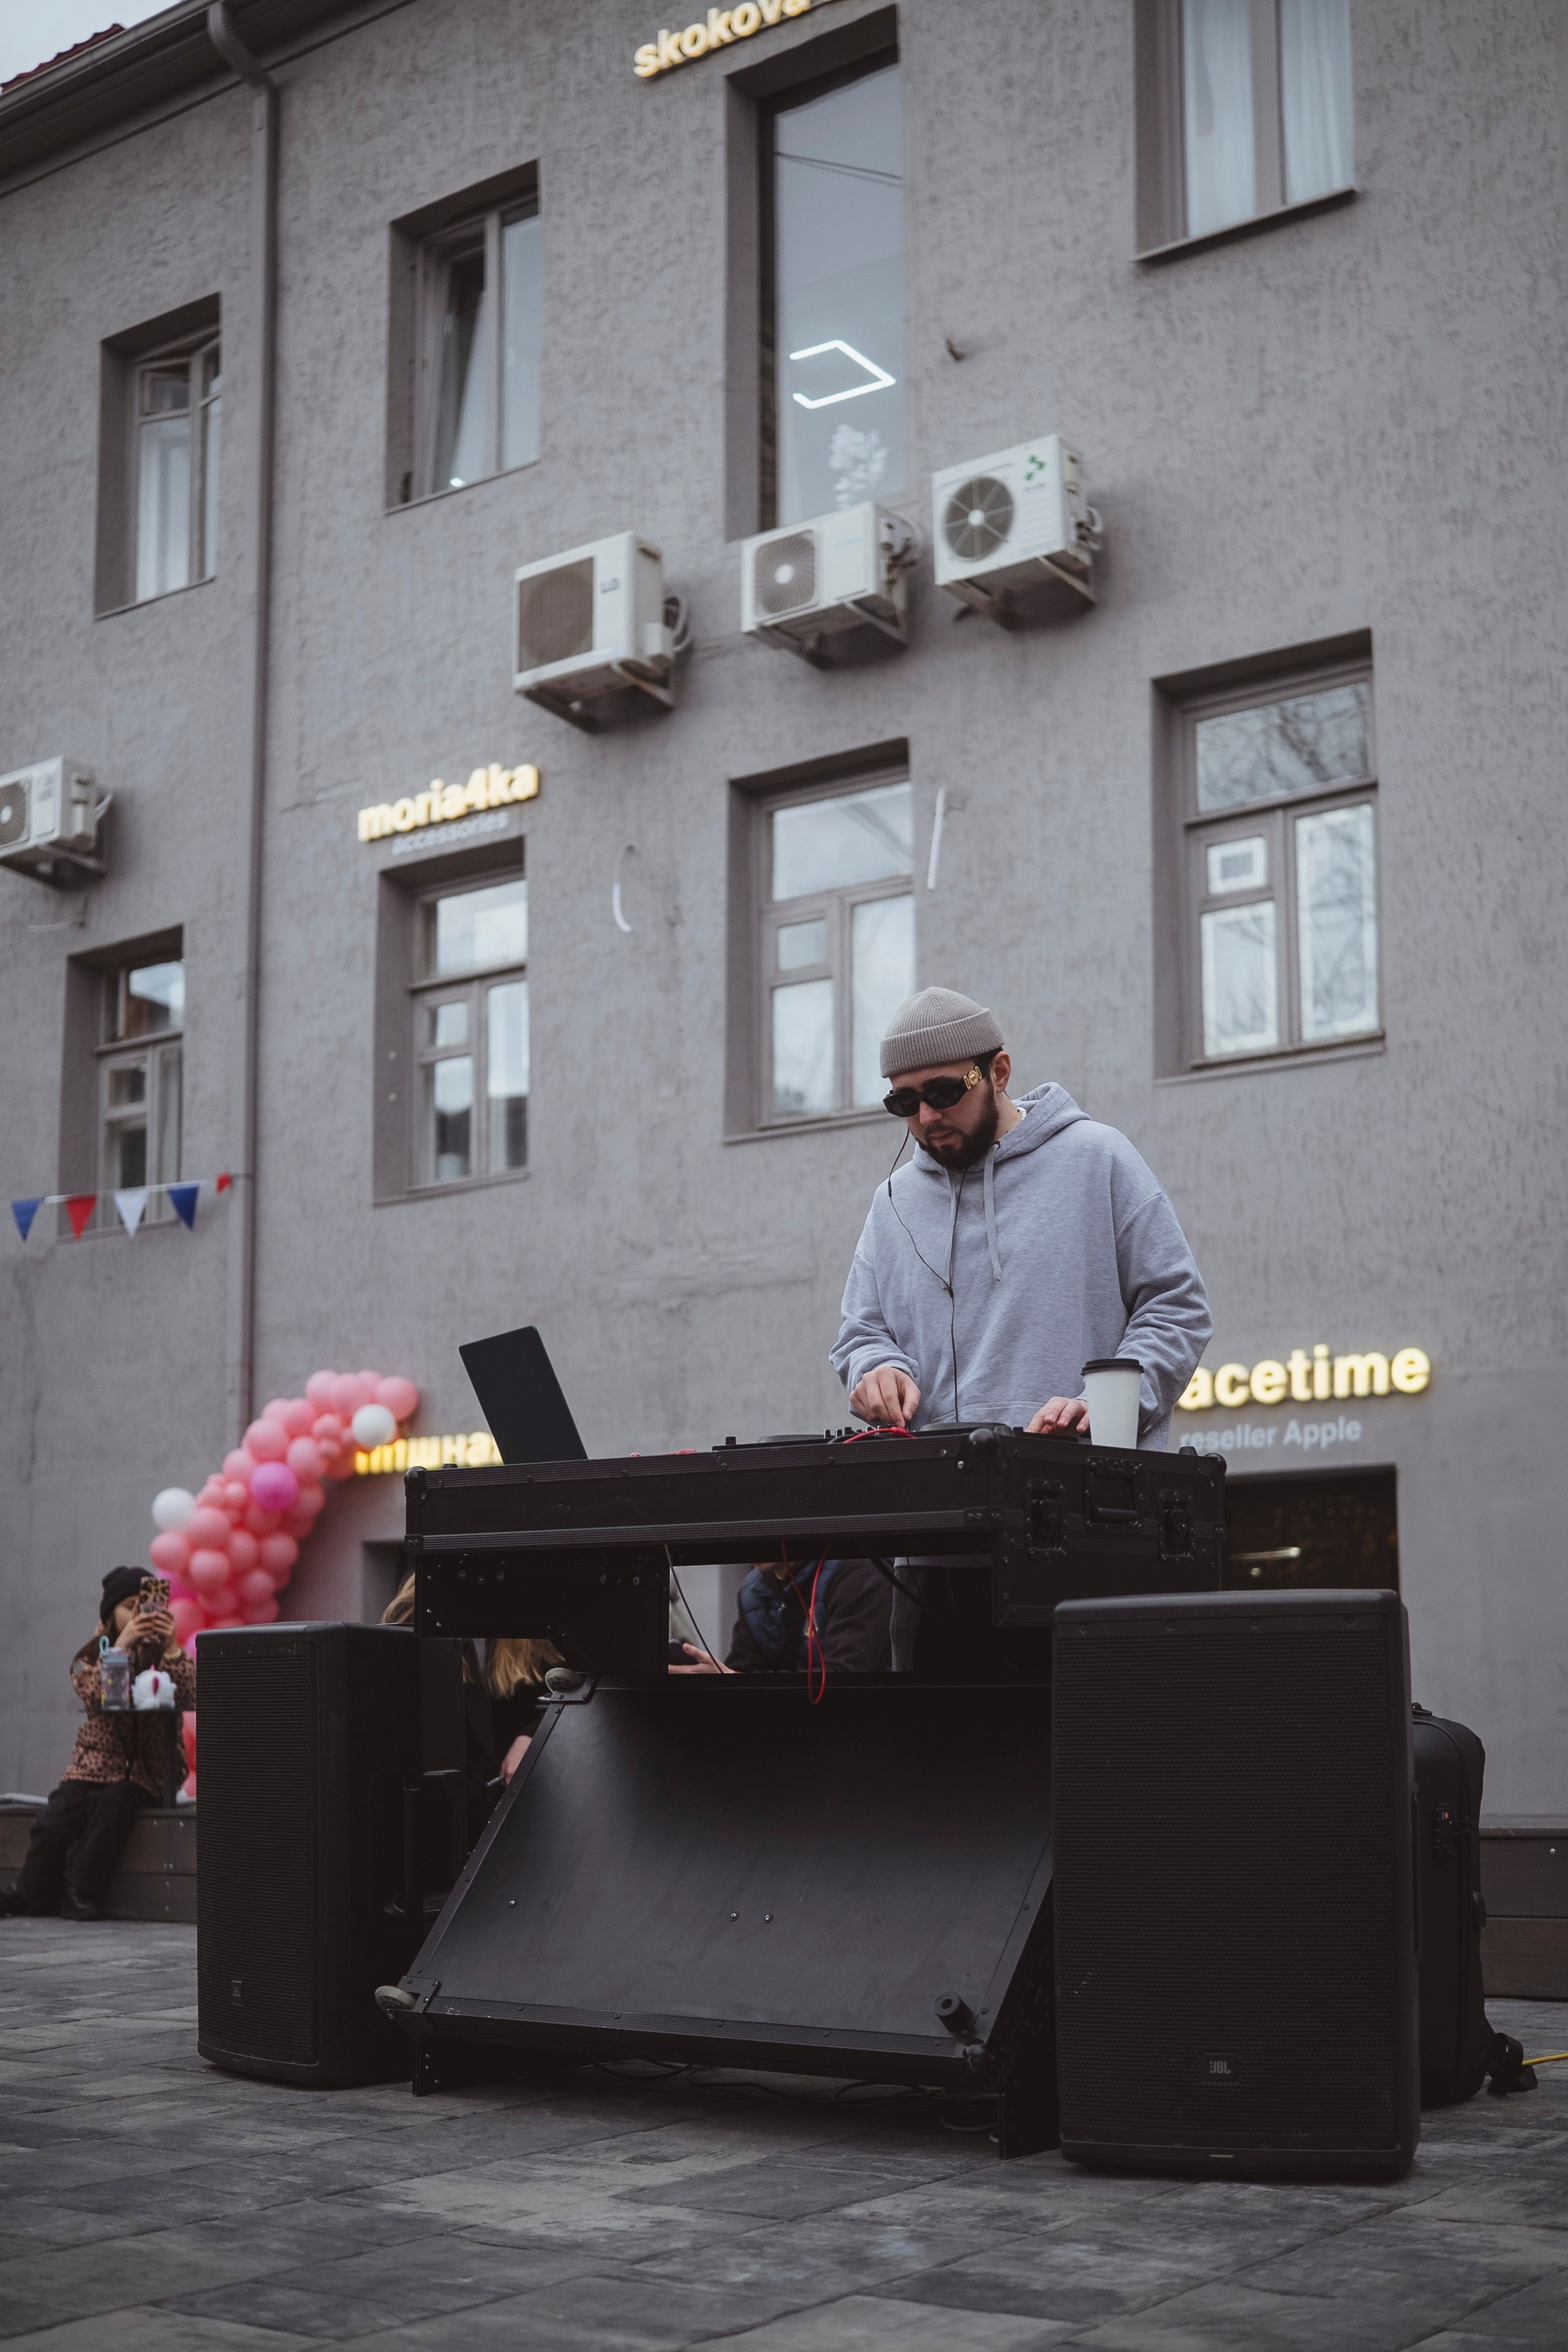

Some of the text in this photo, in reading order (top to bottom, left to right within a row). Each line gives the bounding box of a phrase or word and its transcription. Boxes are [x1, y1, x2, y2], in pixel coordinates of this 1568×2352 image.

[358, 762, 539, 842] moria4ka
[1176, 1344, 1431, 1410] acetime
[1179, 1415, 1362, 1452] reseller Apple
[1209, 2060, 1231, 2074] JBL
